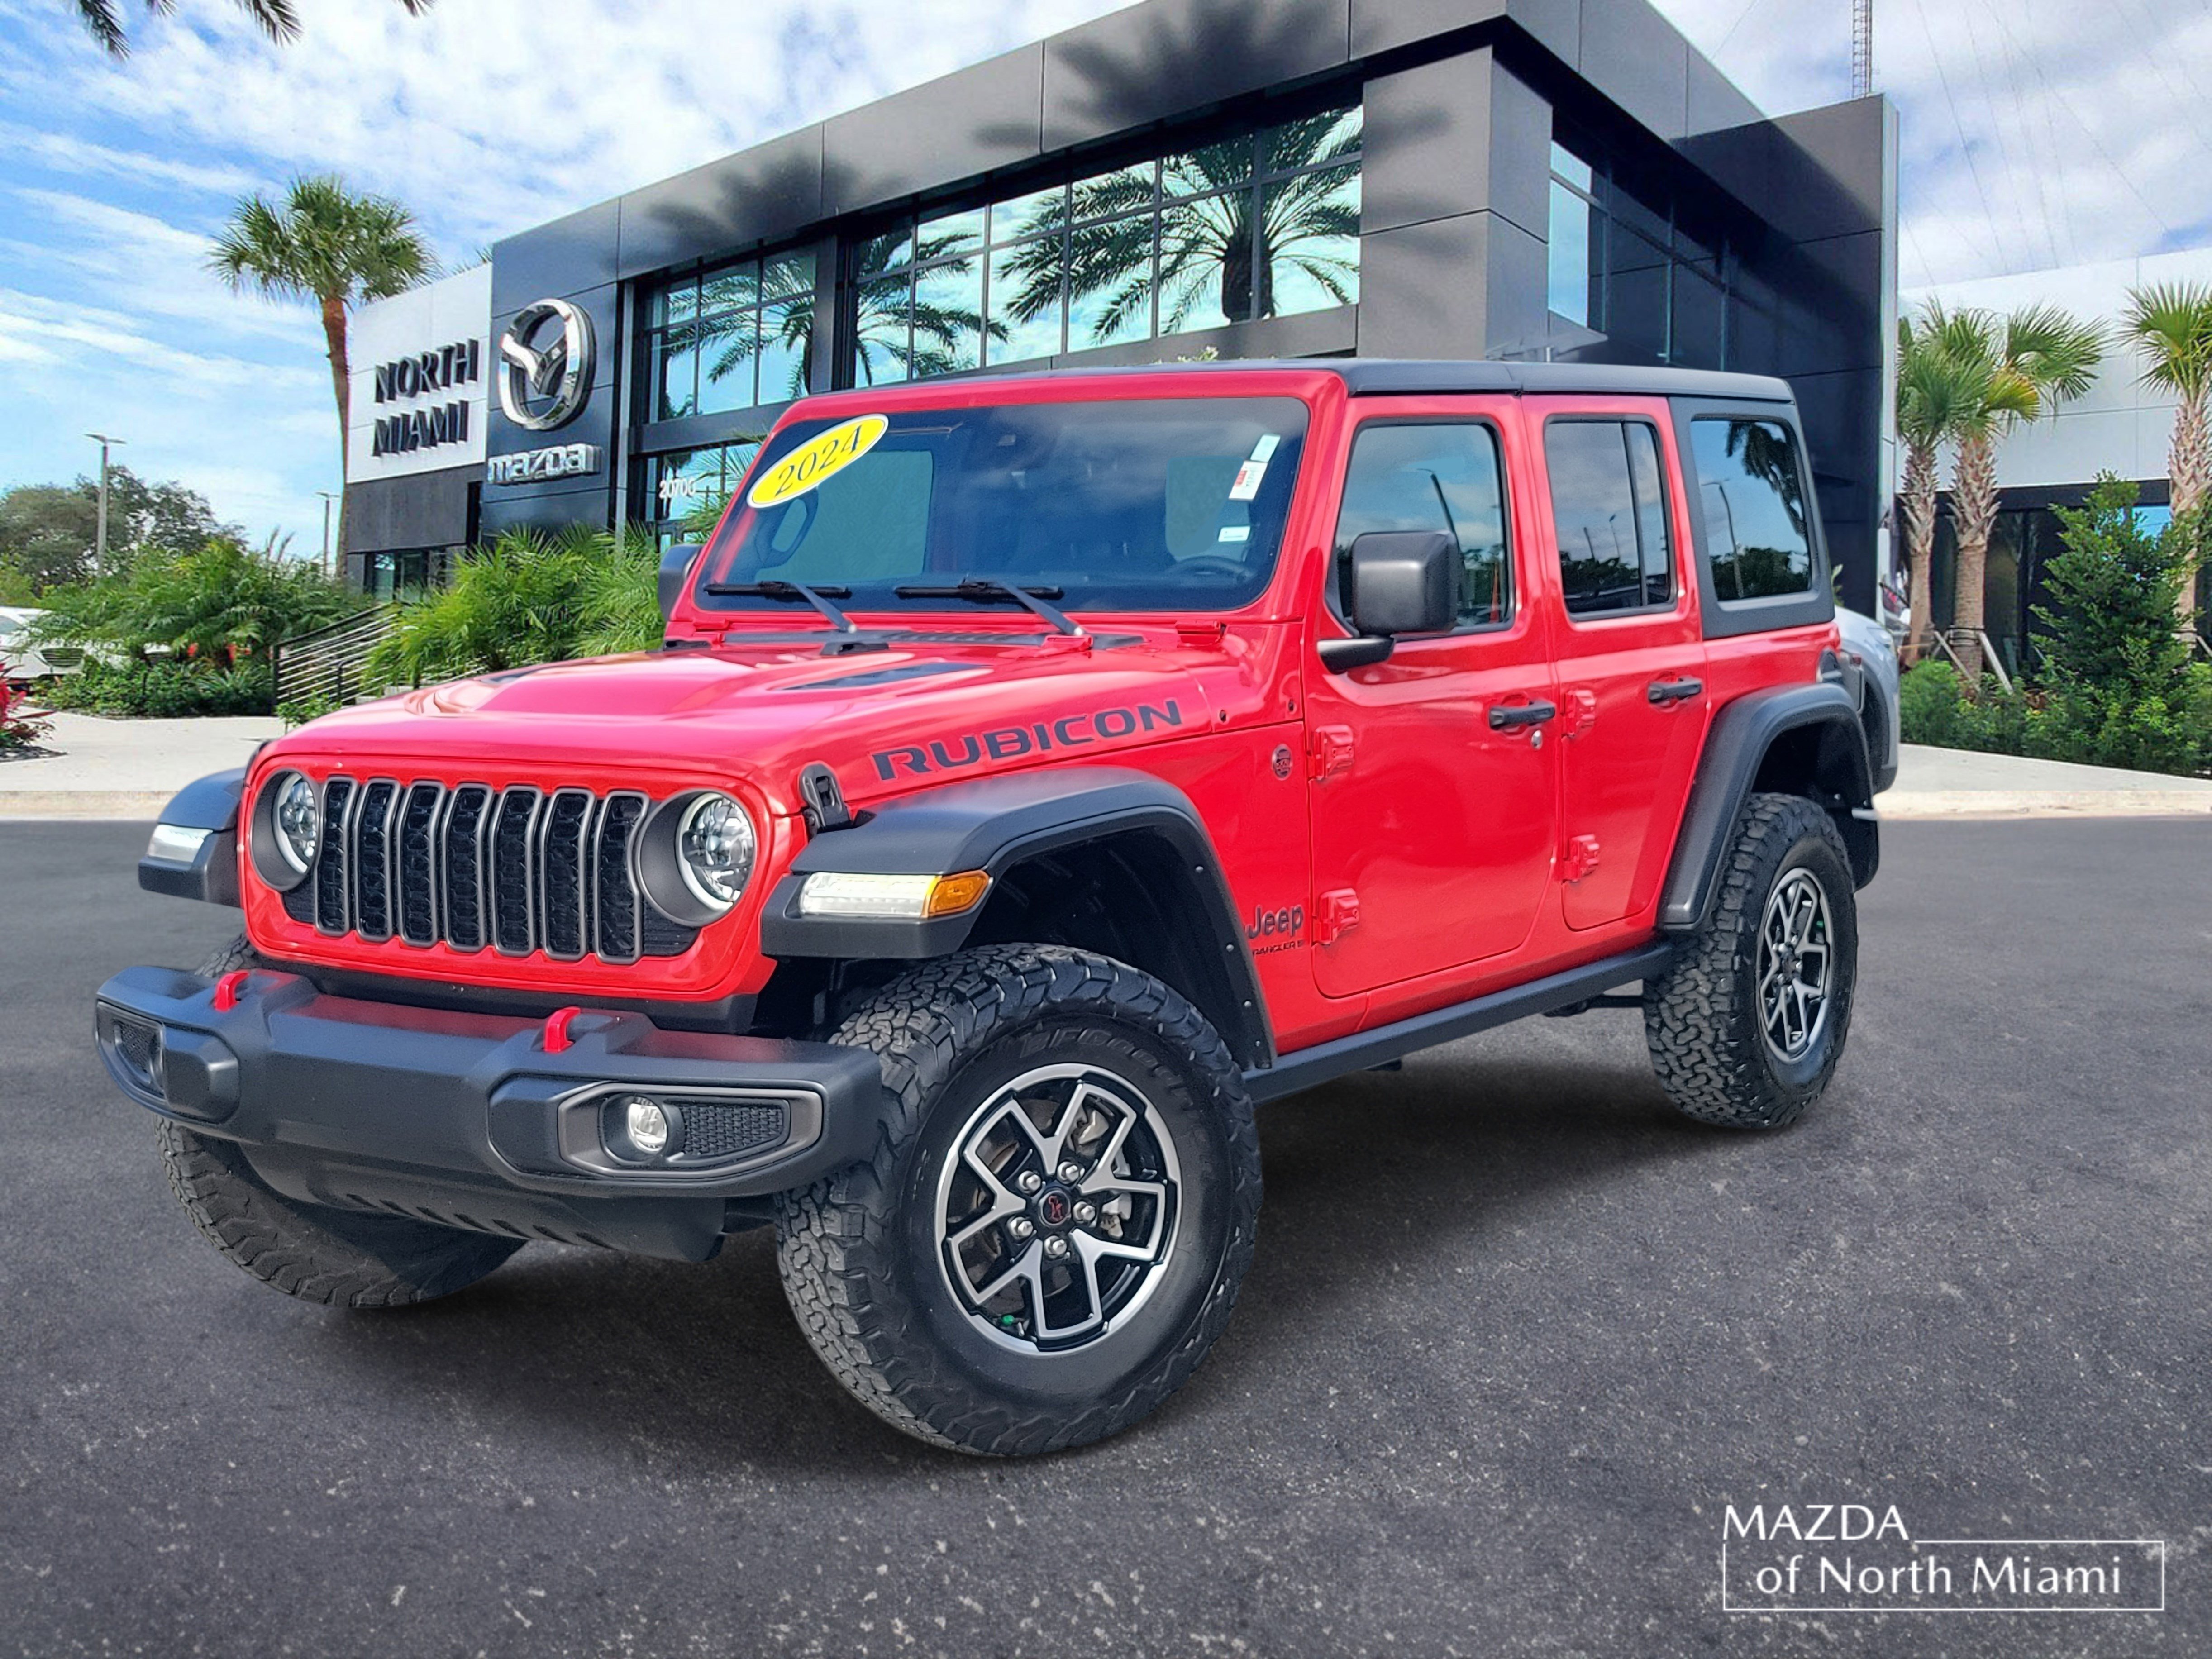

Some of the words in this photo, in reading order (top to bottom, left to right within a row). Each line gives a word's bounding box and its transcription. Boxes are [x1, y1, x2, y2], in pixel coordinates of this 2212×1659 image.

[375, 338, 479, 403] NORTH
[372, 400, 469, 457] MIAMI
[488, 443, 597, 484] mazda
[774, 424, 862, 497] 2024
[872, 700, 1182, 781] RUBICON
[1245, 904, 1304, 939] Jeep
